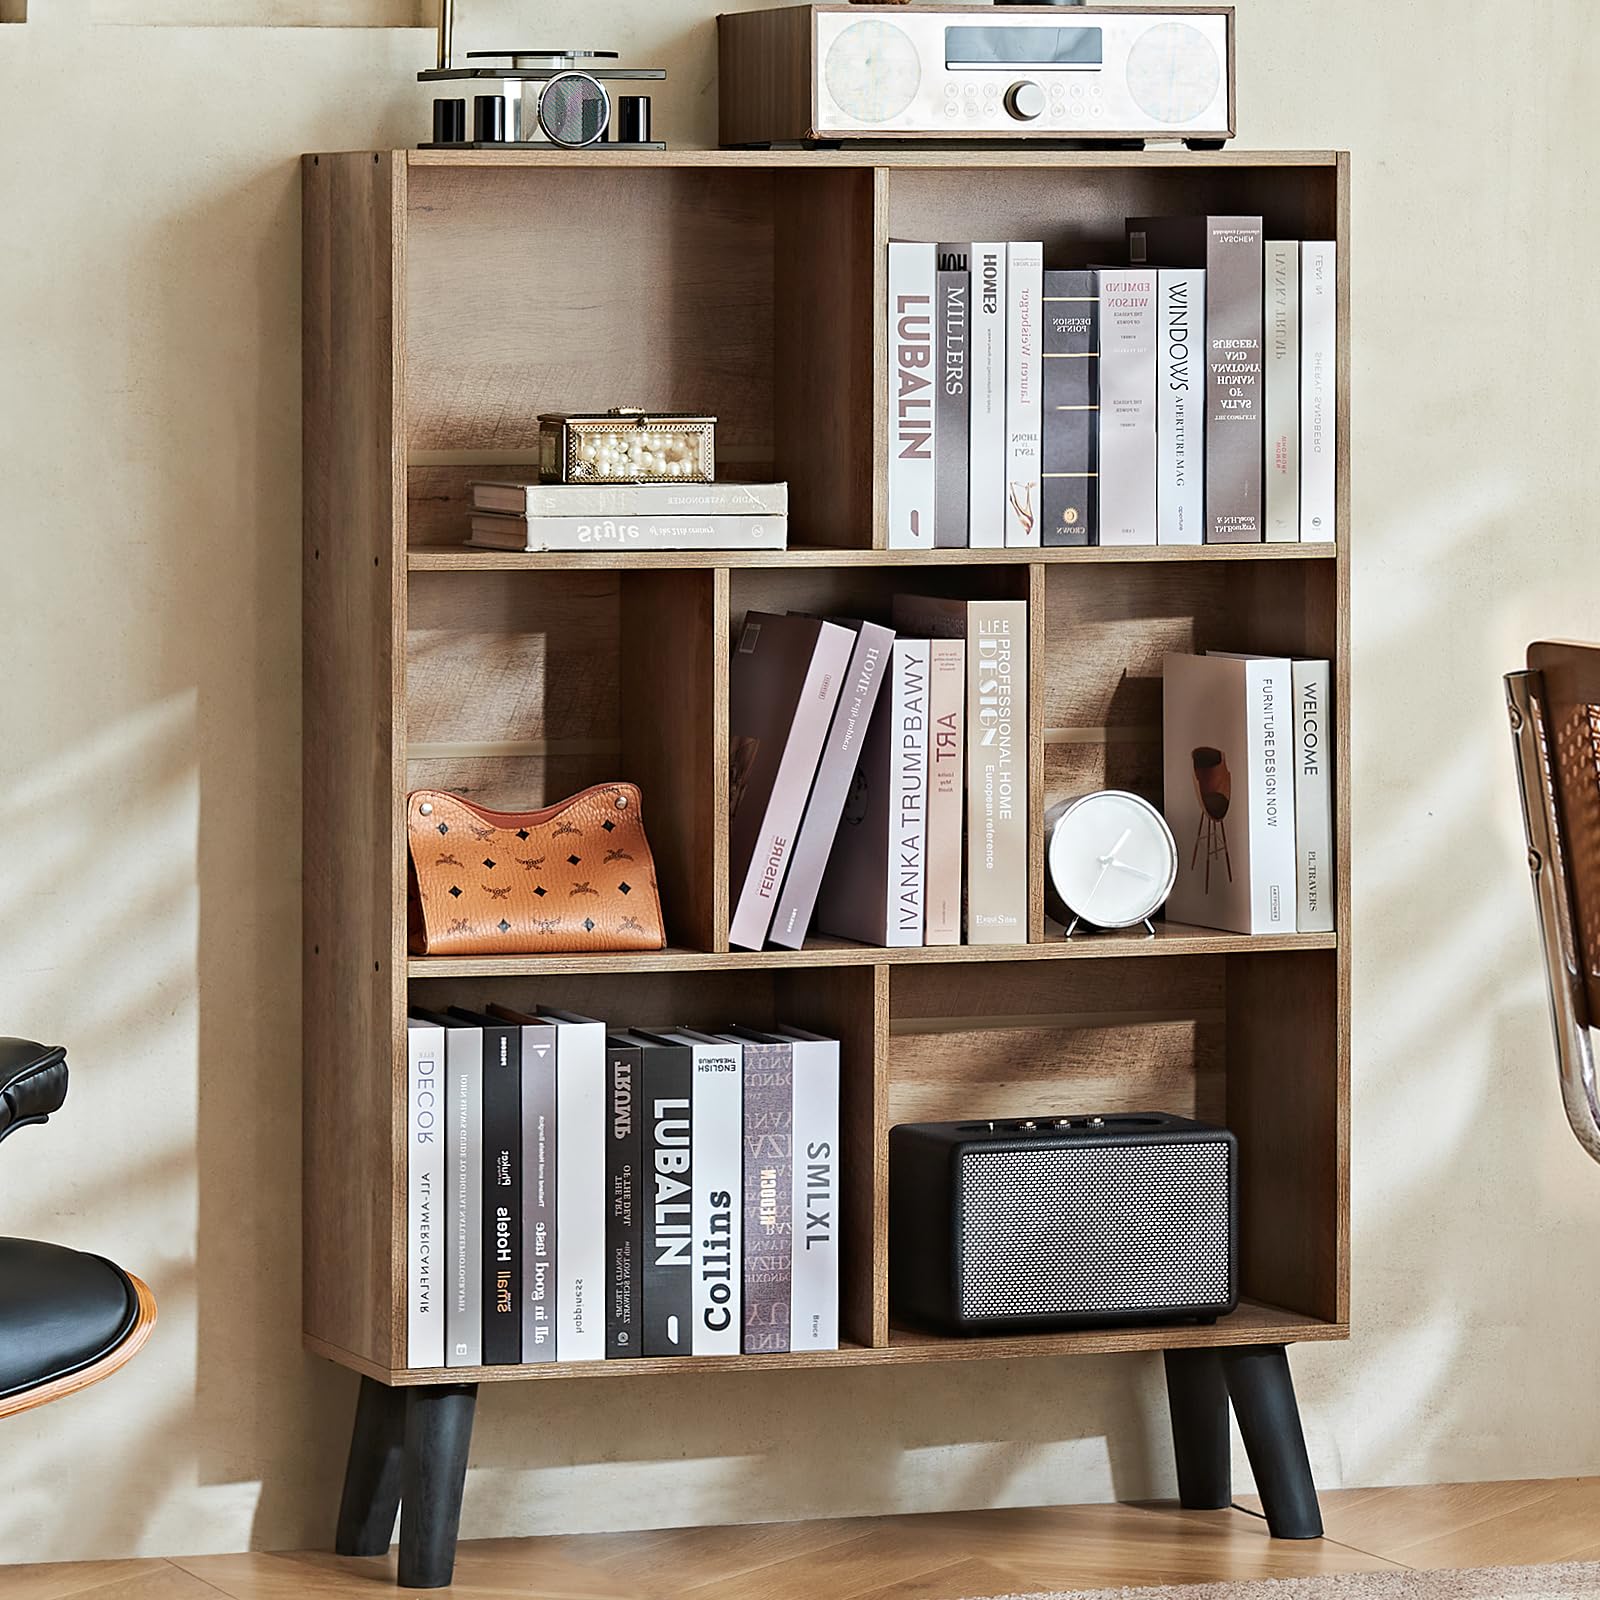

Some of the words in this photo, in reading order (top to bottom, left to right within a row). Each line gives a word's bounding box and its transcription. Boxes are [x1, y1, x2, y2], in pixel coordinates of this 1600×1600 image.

[945, 286, 965, 396] MILLERS
[1169, 281, 1189, 391] WINDOWS
[897, 295, 932, 459] LUBALIN
[1175, 396, 1185, 457] APERTURE
[1175, 459, 1185, 487] MAG
[979, 620, 1010, 634] LIFE
[978, 639, 998, 747] DESIGN
[998, 639, 1011, 768] PROFESSIONAL
[1262, 678, 1275, 746] FURNITURE
[1303, 682, 1319, 776] WELCOME
[901, 653, 924, 828] TRUMPBAWY
[1264, 749, 1277, 795] DESIGN
[984, 764, 995, 816] European
[999, 771, 1012, 820] HOME
[1266, 798, 1278, 828] NOW
[900, 834, 921, 931] IVANKA
[985, 818, 995, 870] reference
[698, 1064, 737, 1072] ENGLISH
[654, 1099, 692, 1266] LUBALIN
[806, 1142, 831, 1251] SMLXL
[703, 1190, 731, 1332] Collins
[812, 1314, 820, 1339] Bruce
